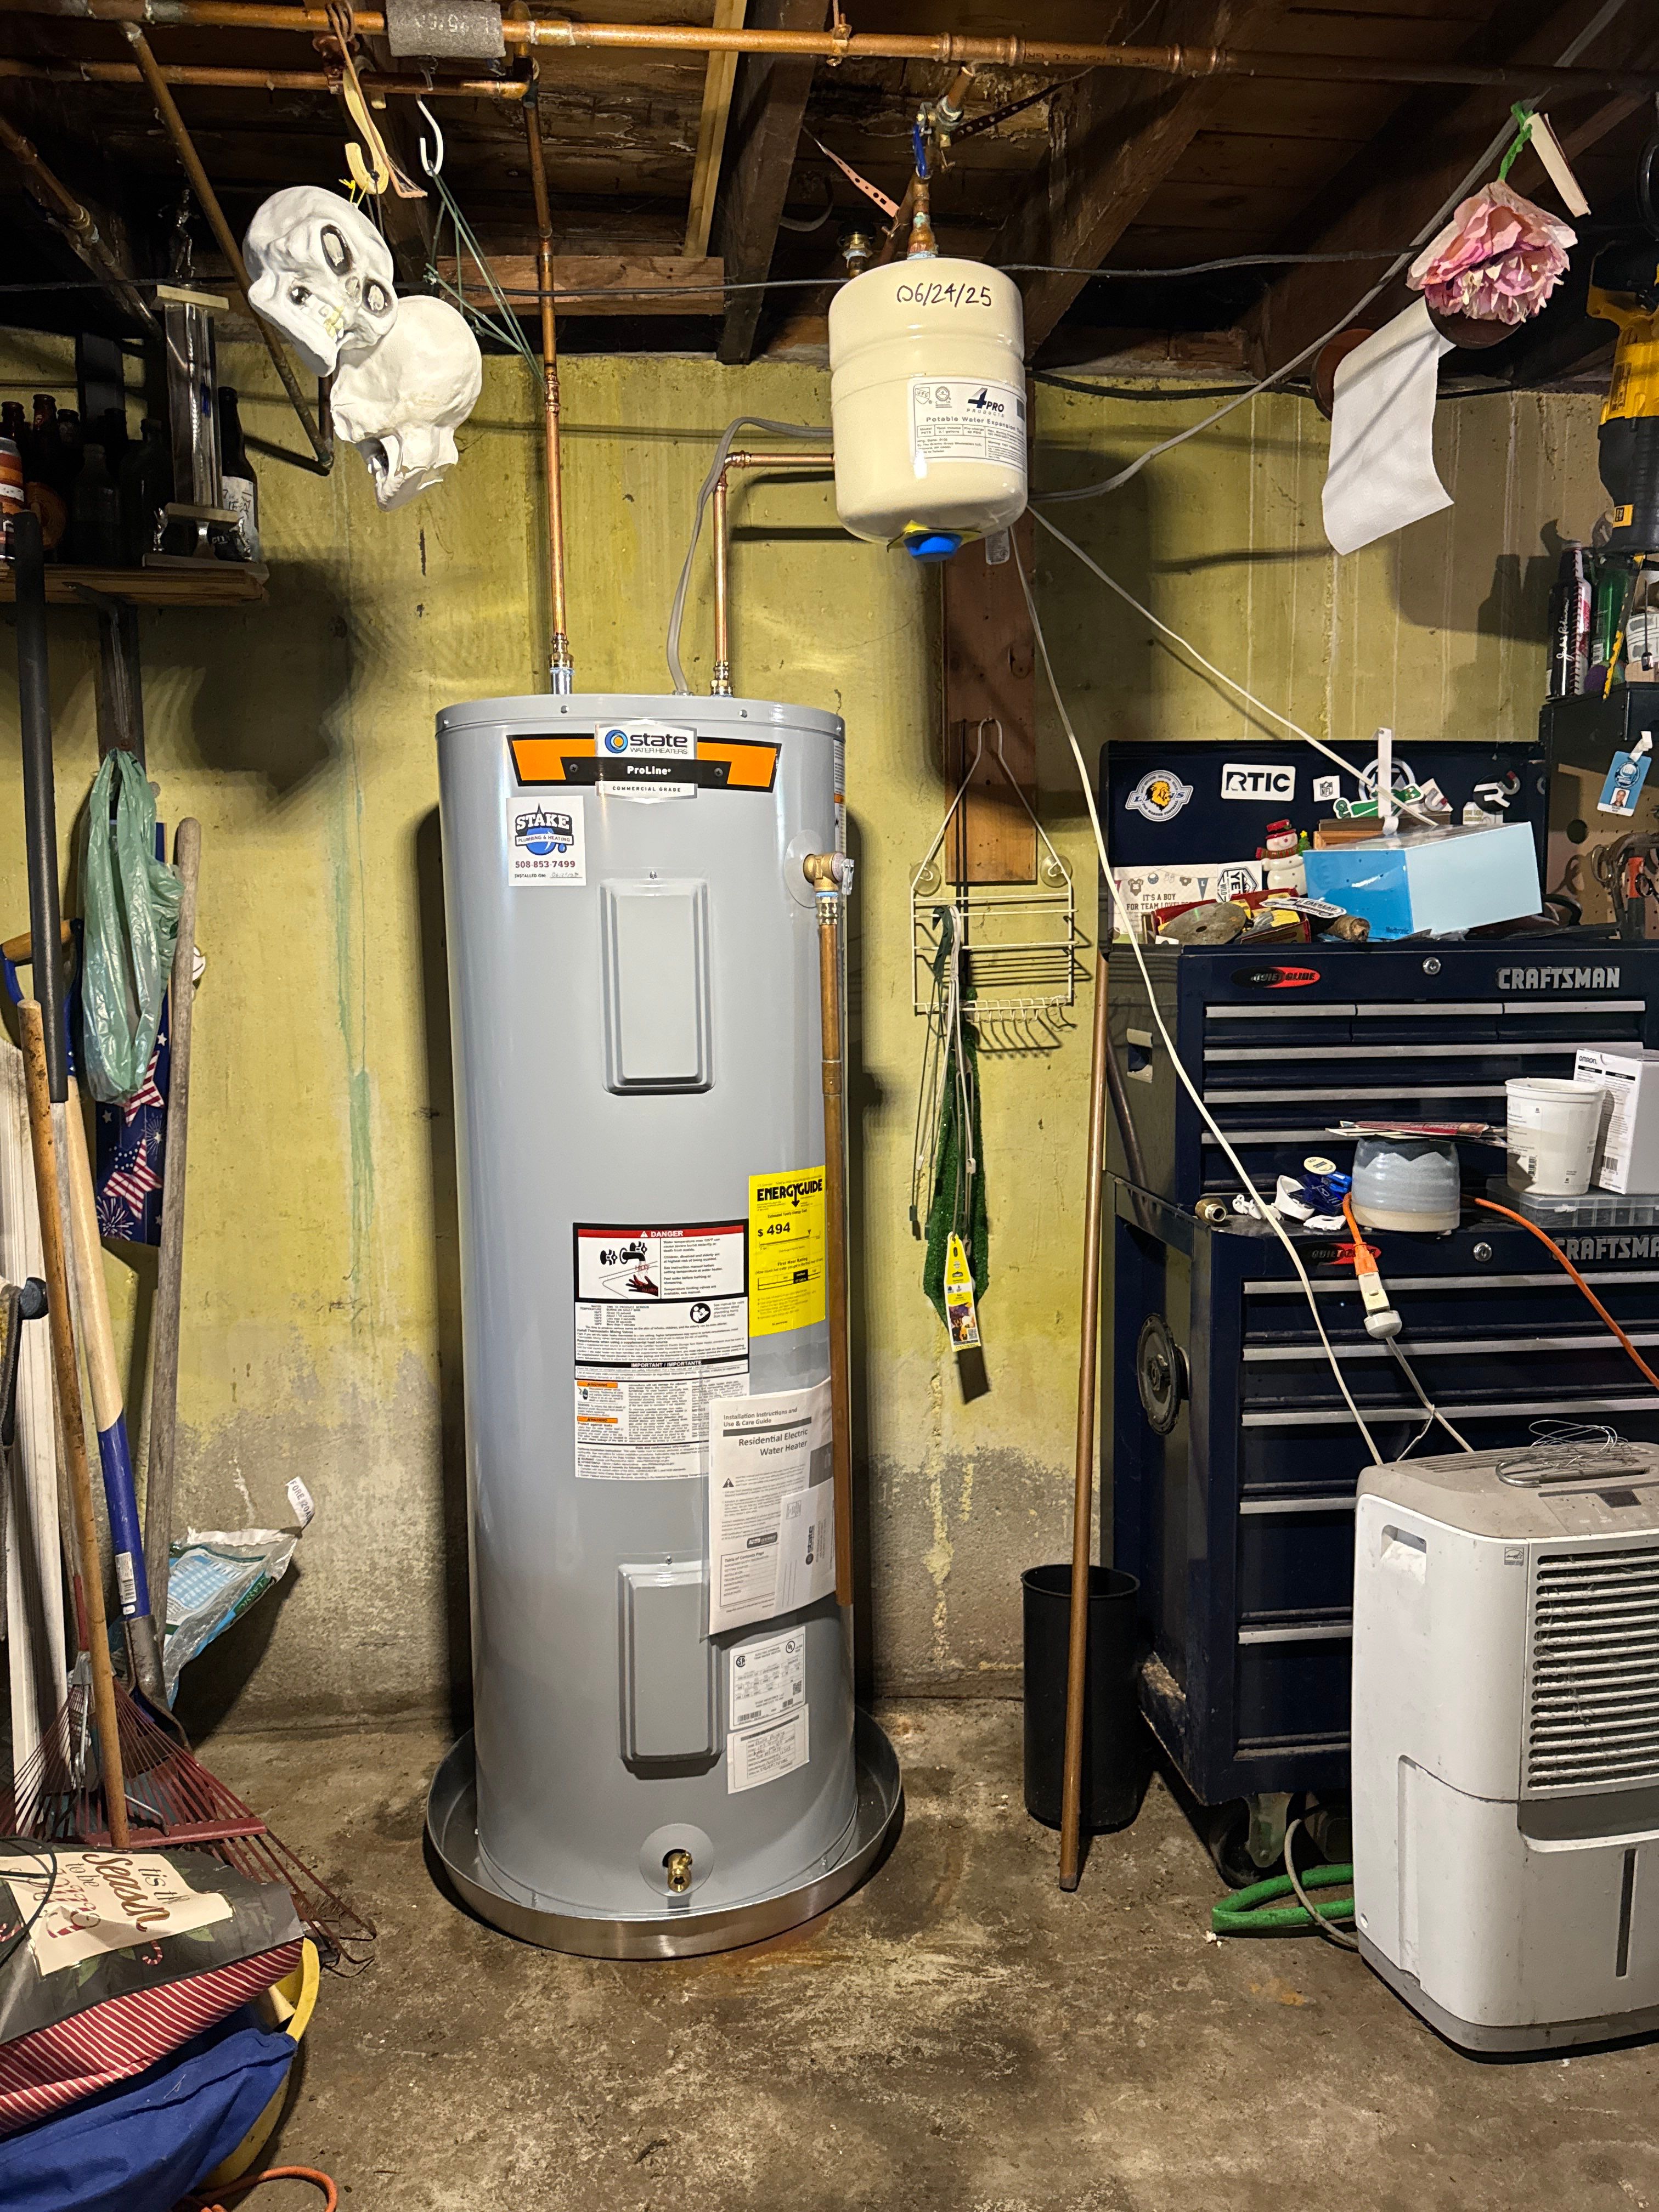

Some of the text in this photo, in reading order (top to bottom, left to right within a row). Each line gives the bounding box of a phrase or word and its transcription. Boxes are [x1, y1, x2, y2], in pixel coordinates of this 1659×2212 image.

[897, 283, 991, 307] 06/24/25
[967, 408, 1005, 417] PRODUCTS
[986, 401, 1005, 413] PRO
[988, 419, 1015, 431] Expansion
[630, 733, 687, 748] state
[1226, 771, 1290, 792] RTIC
[1321, 787, 1333, 796] NFL
[516, 813, 570, 830] STAKE
[1497, 967, 1620, 989] CRAFTSMAN
[757, 1178, 822, 1201] ENERGYGUIDE
[758, 1222, 791, 1237] $ 494
[739, 1429, 808, 1446] Residential Electric
[760, 1440, 808, 1456] Water Heater
[65, 1863, 100, 1887] to be
